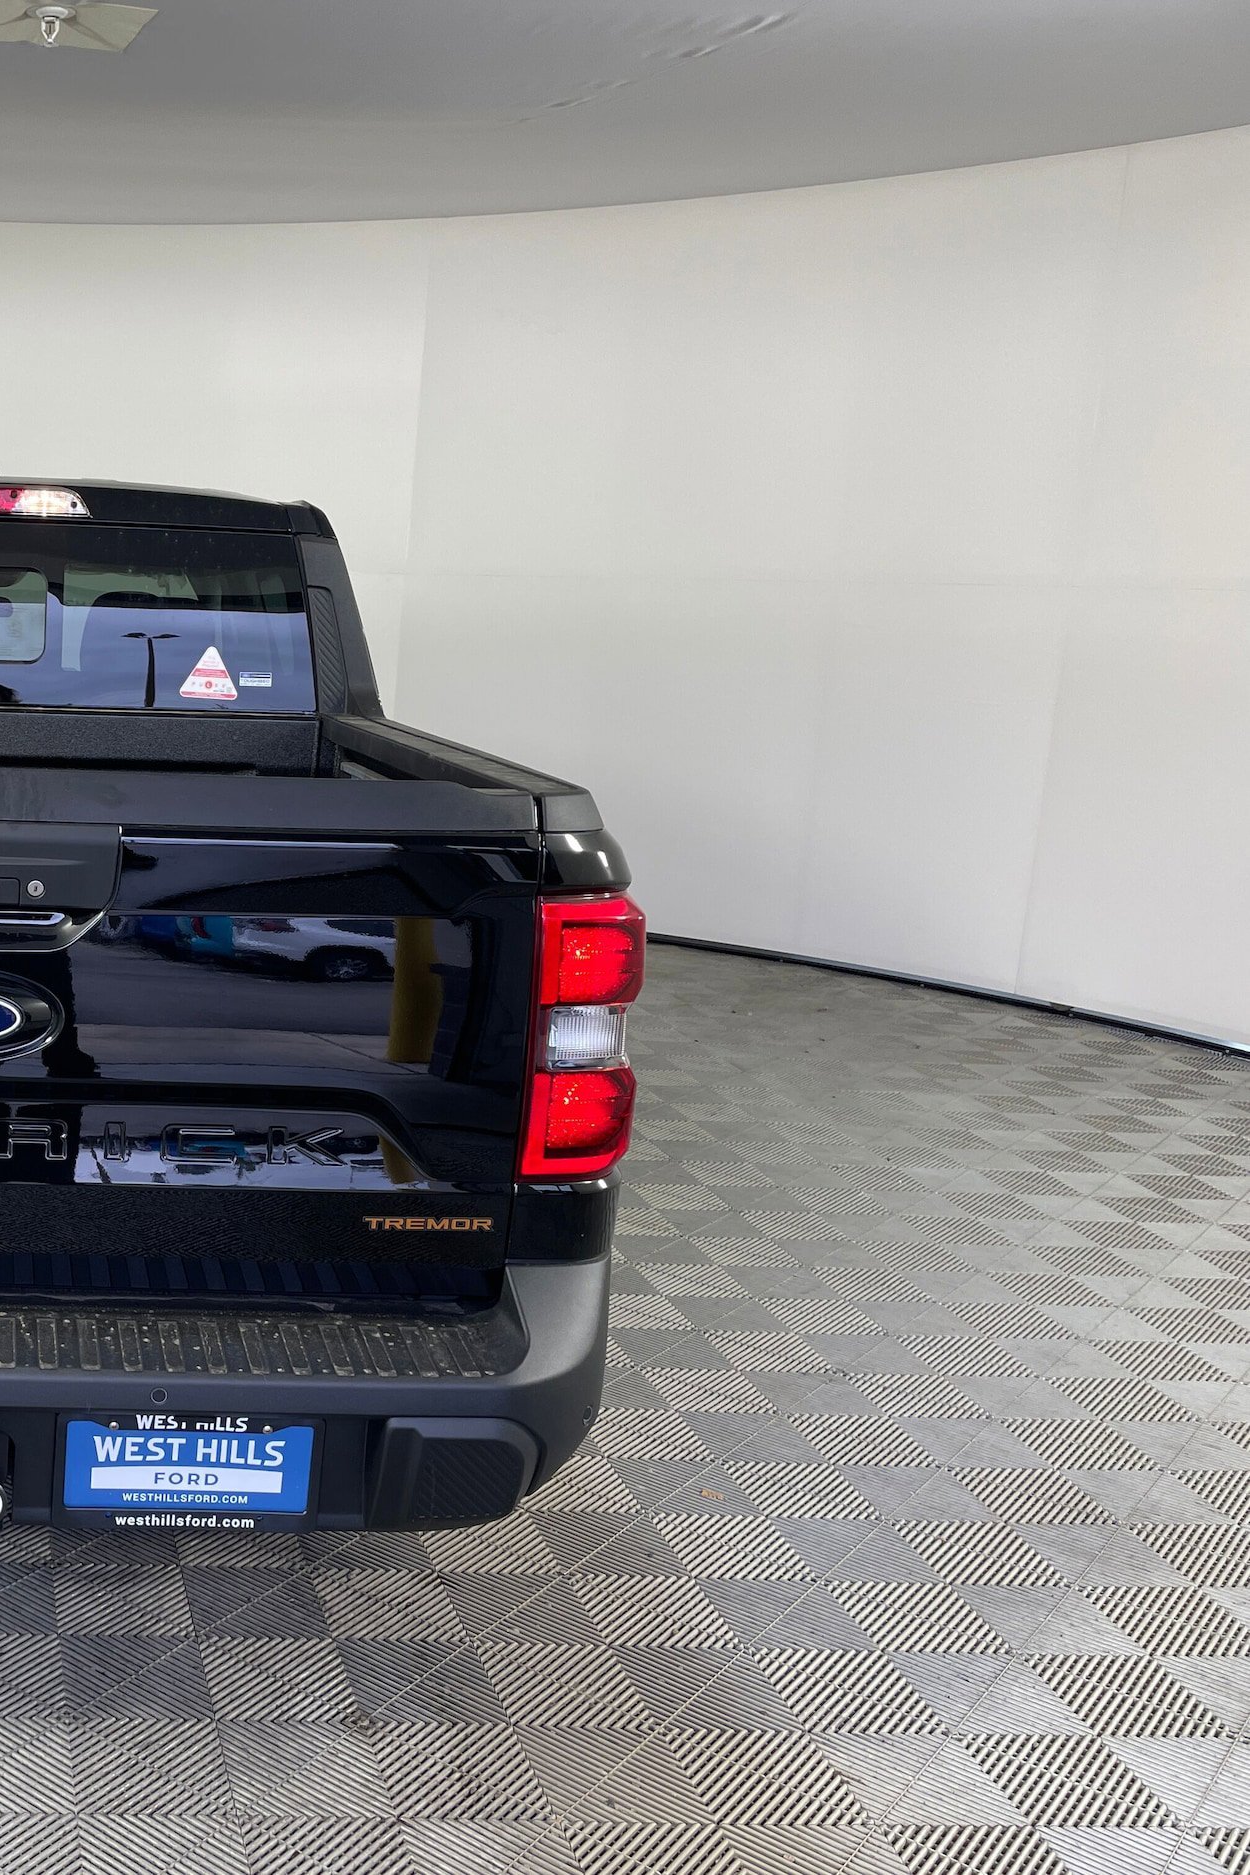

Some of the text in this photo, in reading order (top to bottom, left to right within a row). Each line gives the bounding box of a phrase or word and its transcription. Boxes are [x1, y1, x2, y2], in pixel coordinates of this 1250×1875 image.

[364, 1216, 492, 1232] TREMOR
[92, 1435, 286, 1467] WEST HILLS
[153, 1472, 219, 1486] FORD
[122, 1492, 248, 1505] WESTHILLSFORD.COM
[115, 1513, 255, 1529] westhillsford.com
